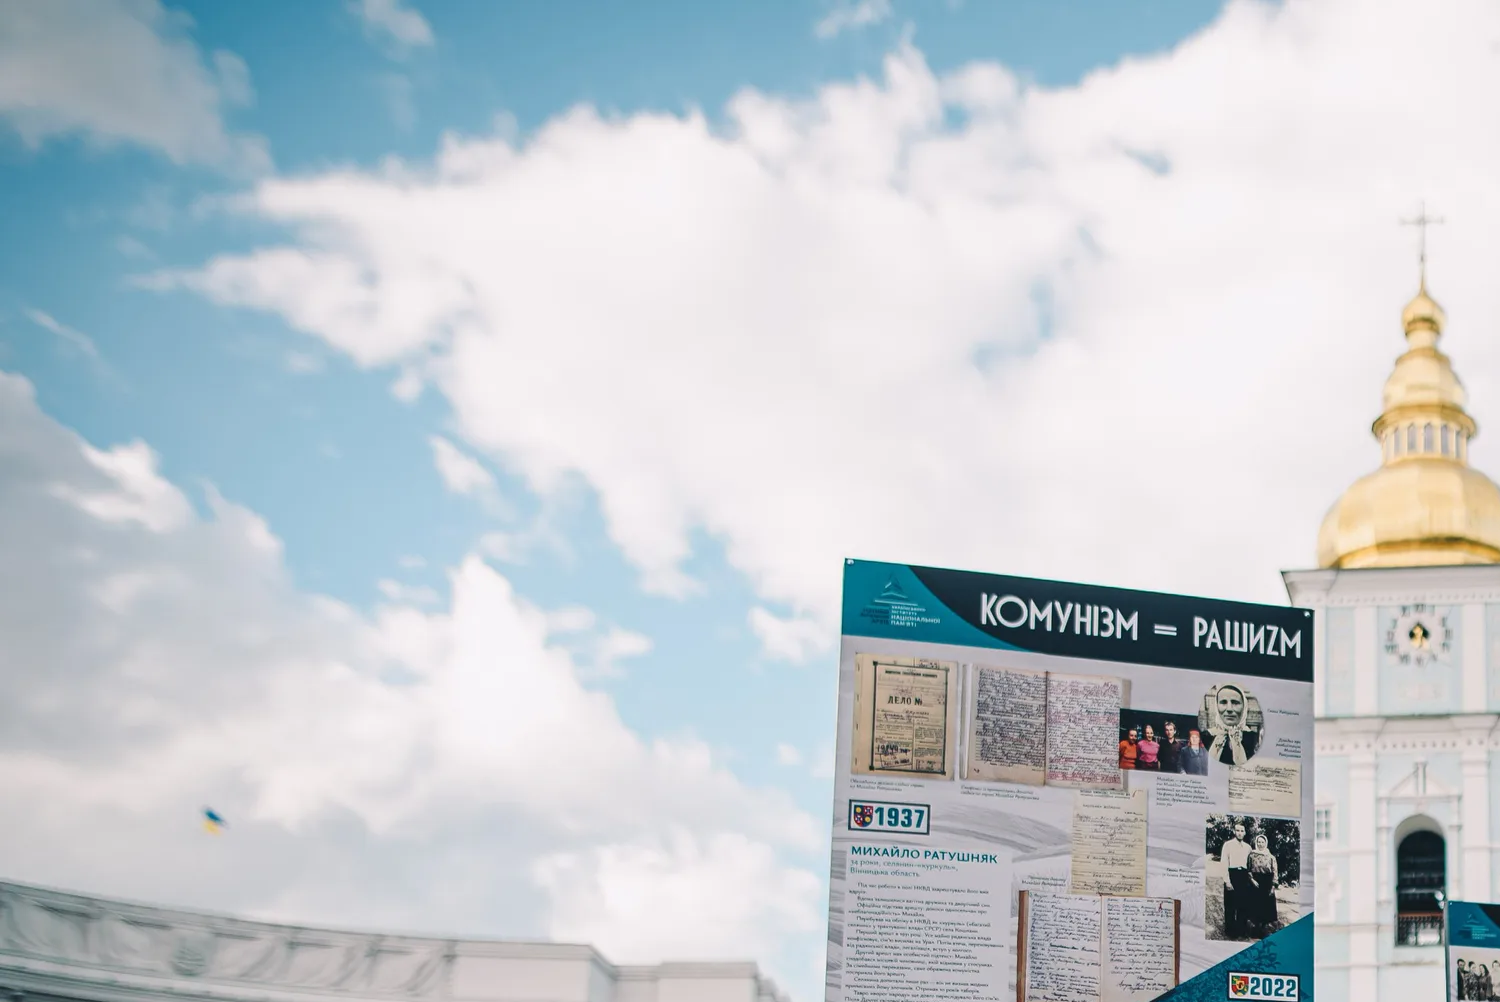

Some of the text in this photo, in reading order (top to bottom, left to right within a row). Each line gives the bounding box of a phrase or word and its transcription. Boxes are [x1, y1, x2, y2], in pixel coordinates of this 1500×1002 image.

[980, 592, 1138, 641] КОМУНІЗМ
[888, 696, 911, 705] ДЕЛО
[874, 806, 925, 828] 1937
[852, 846, 997, 864] МИХАЙЛО РАТУШНЯК
[1250, 976, 1297, 998] 2022
